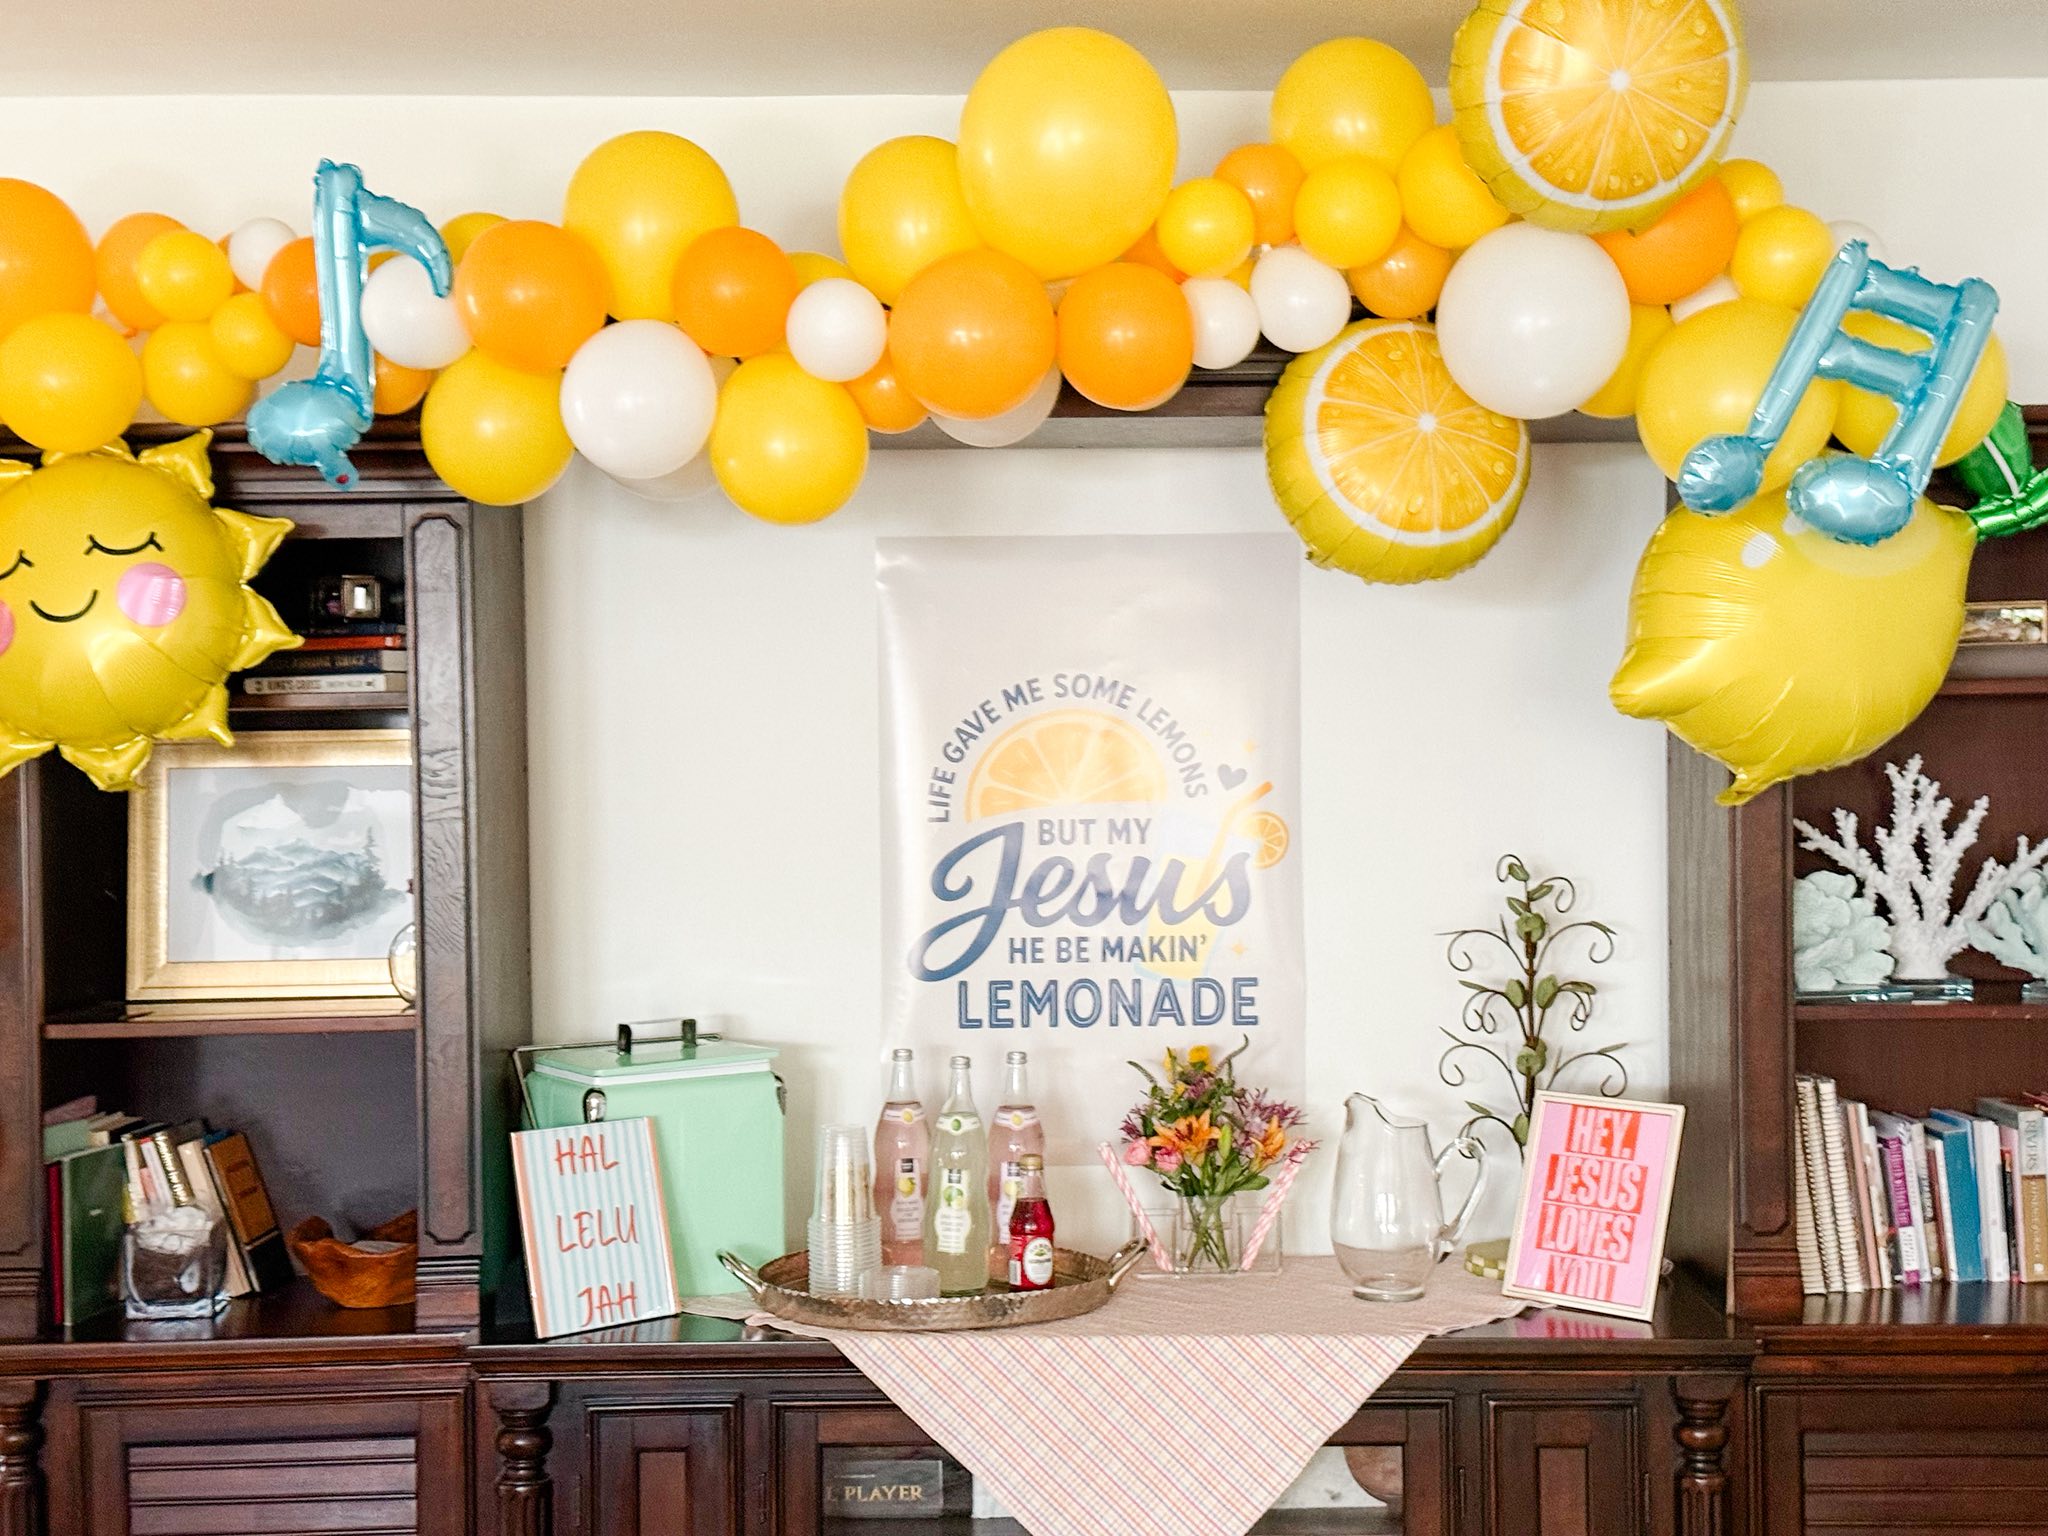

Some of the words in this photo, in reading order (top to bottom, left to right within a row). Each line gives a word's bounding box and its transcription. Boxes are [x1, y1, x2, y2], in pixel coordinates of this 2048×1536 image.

[927, 766, 955, 823] LIFE
[942, 699, 1003, 764] GAVE
[1001, 677, 1044, 714] ME
[1053, 672, 1137, 710] SOME
[1136, 697, 1209, 800] LEMONS
[1038, 818, 1096, 846] BUT
[1108, 817, 1152, 845] MY
[907, 821, 1252, 982] Jesus
[1009, 937, 1044, 964] HE
[1056, 936, 1089, 963] BE
[1101, 935, 1207, 963] MAKIN'
[957, 976, 1260, 1030] LEMONADE
[555, 1134, 619, 1176] HAL
[1548, 1154, 1641, 1212] JESUS
[556, 1204, 639, 1253] LELU
[1542, 1204, 1632, 1261] LOVES
[1552, 1256, 1611, 1301] YOU
[577, 1280, 638, 1328] JAH
[845, 1485, 922, 1501] PLAYER
